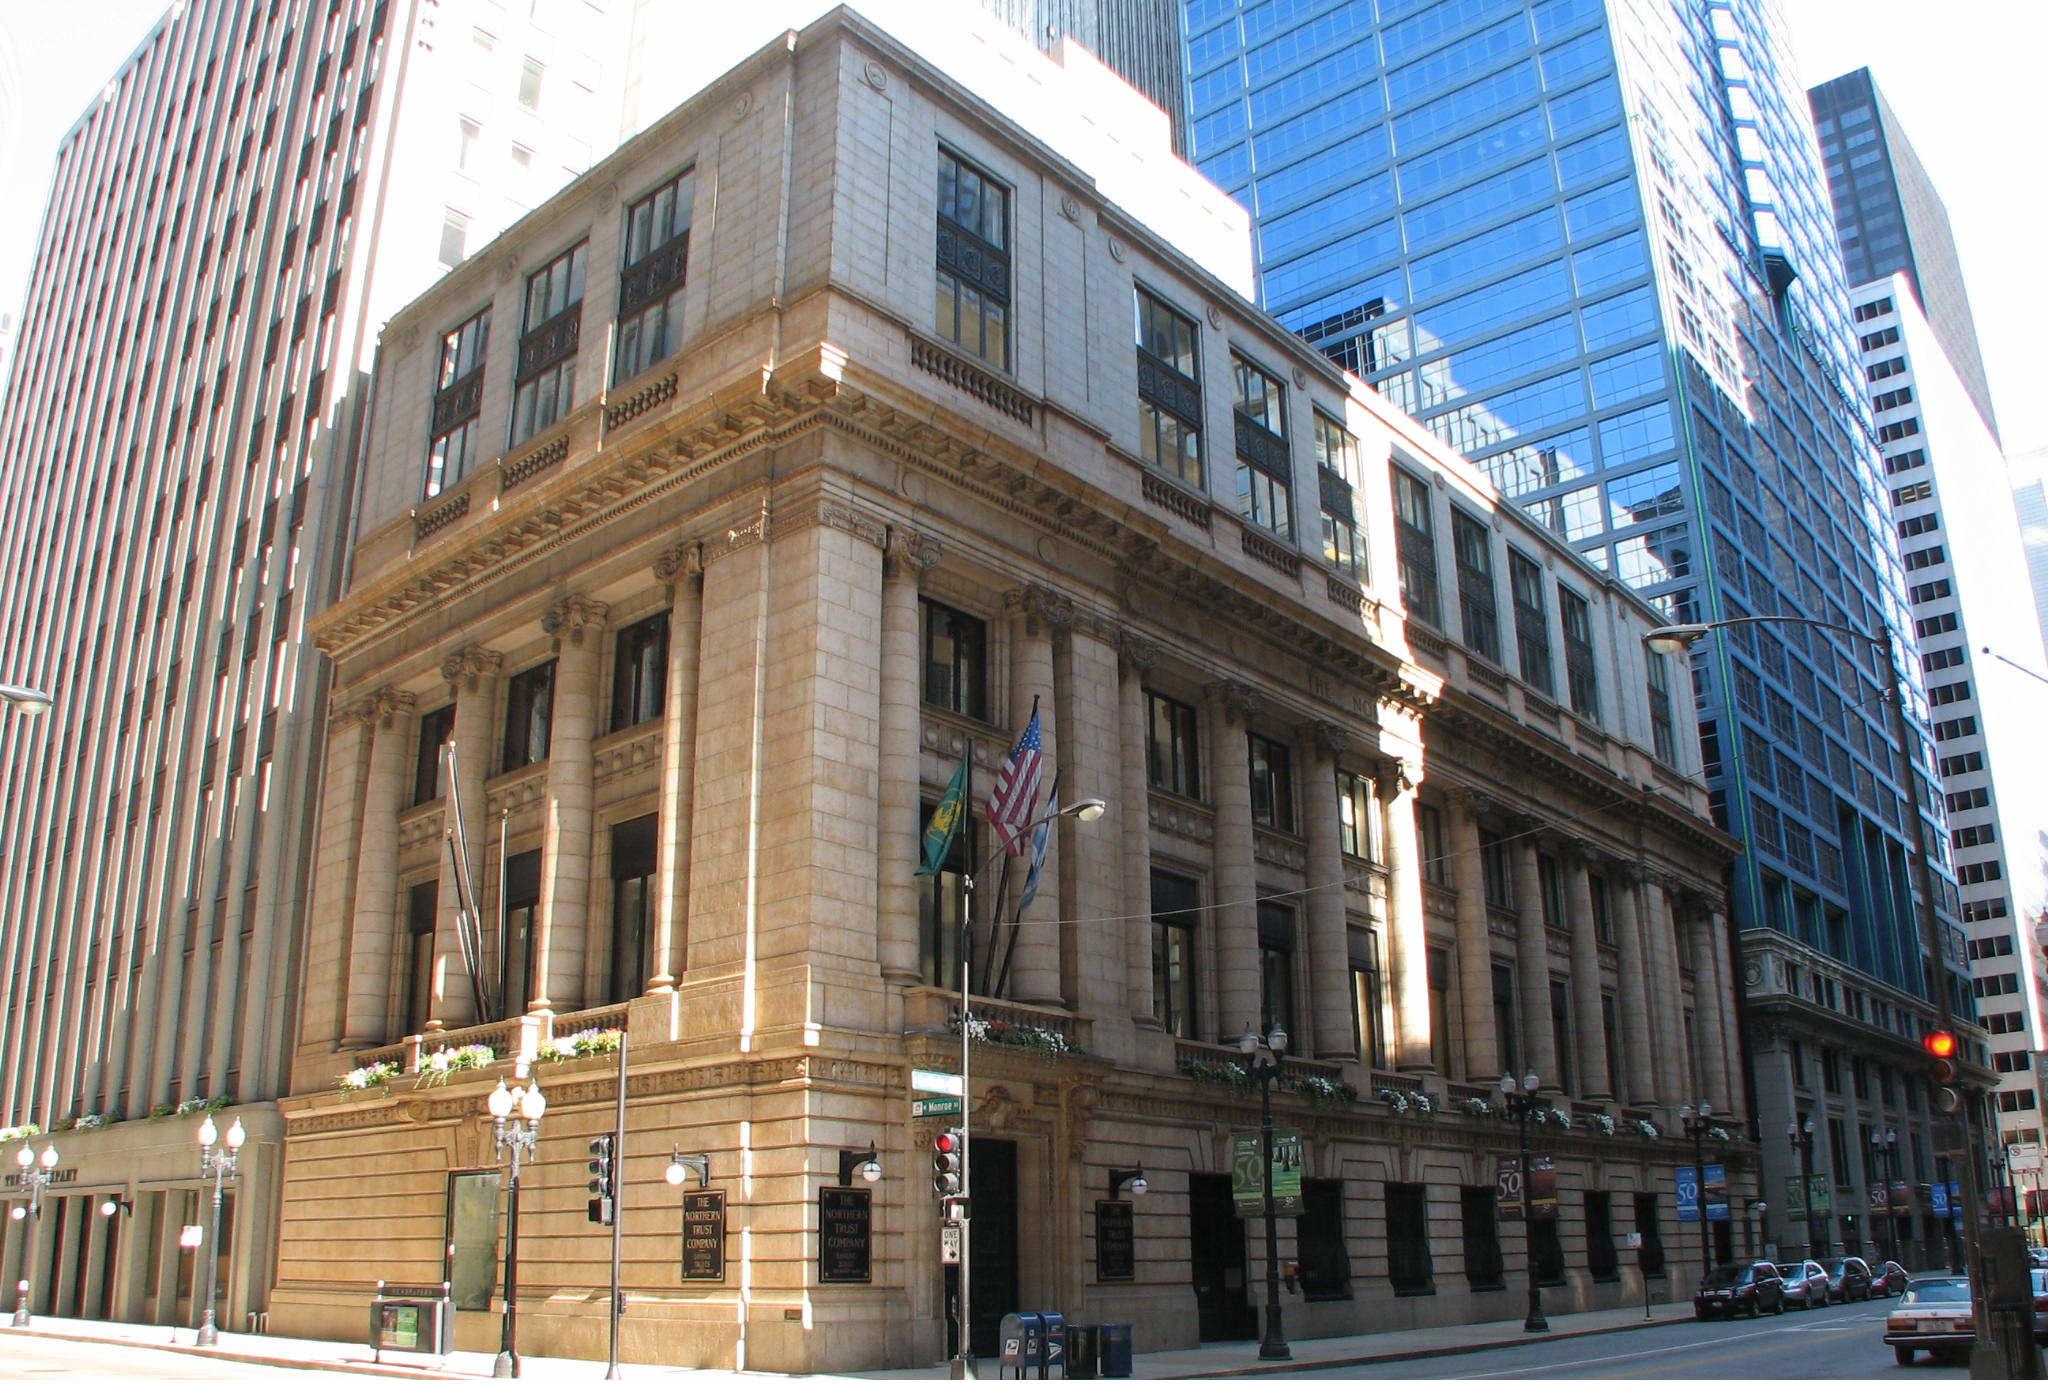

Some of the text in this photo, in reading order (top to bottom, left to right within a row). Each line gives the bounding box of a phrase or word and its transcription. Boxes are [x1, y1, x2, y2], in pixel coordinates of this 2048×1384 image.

[929, 1101, 952, 1112] Monroe
[1232, 1156, 1262, 1191] 50
[1497, 1171, 1520, 1200] 50
[1677, 1182, 1697, 1205] 50
[1870, 1189, 1887, 1207] 50
[697, 1197, 710, 1207] THE
[840, 1195, 855, 1206] THE
[1932, 1193, 1948, 1208] 50
[685, 1210, 721, 1221] NORTHERN
[825, 1208, 867, 1219] NORTHERN
[693, 1224, 713, 1235] TRUST
[835, 1223, 858, 1234] TRUST
[944, 1231, 958, 1239] ONE
[687, 1238, 718, 1249] COMPANY
[828, 1237, 865, 1249] COMPANY
[944, 1240, 958, 1249] WAY
